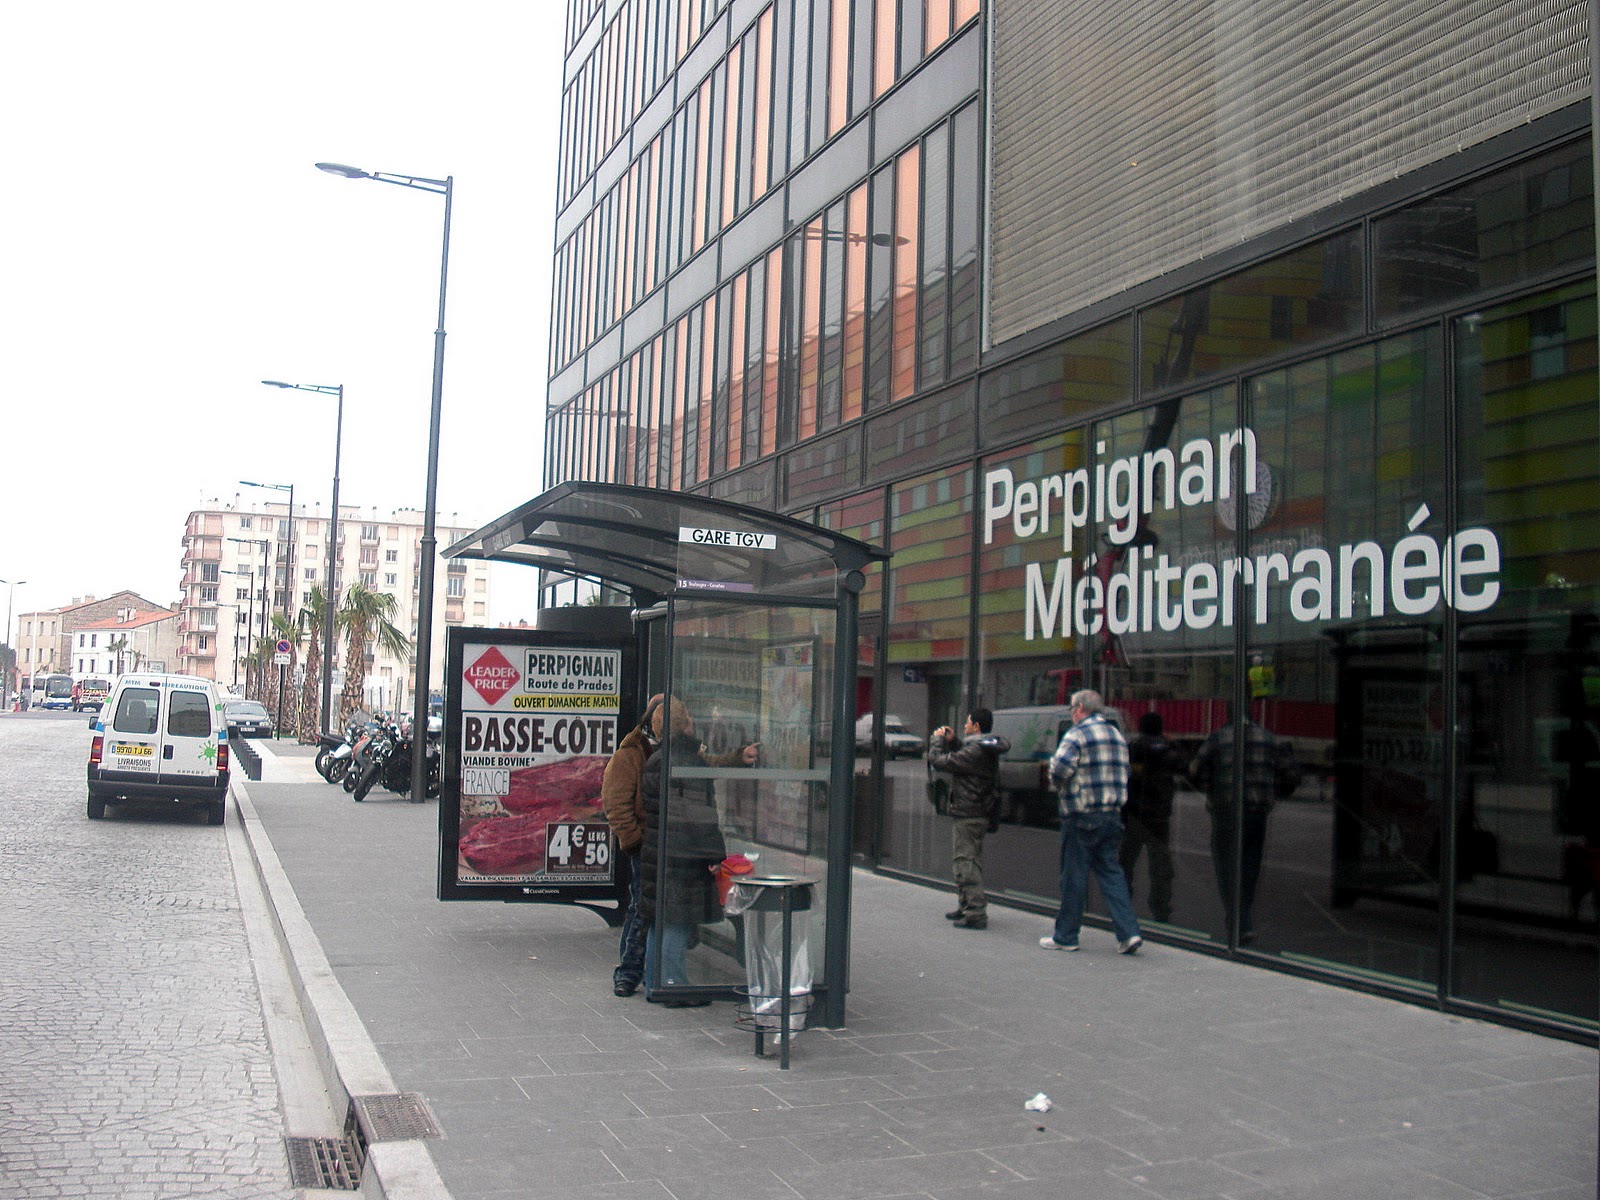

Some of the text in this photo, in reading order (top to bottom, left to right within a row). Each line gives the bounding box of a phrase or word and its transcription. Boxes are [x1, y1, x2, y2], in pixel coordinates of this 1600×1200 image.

[983, 427, 1258, 551] Perpignan
[692, 529, 764, 548] GARE TGV
[1025, 503, 1500, 640] Méditerranée
[470, 666, 516, 678] LEADER
[528, 654, 614, 677] PERPIGNAN
[161, 682, 209, 691] BUREAUTIQUE
[475, 679, 509, 690] PRICE
[528, 678, 613, 691] Route de Prades
[514, 696, 618, 708] OUVERT DIMANCHE MATIN
[465, 716, 615, 755] BASSE-CÔTE
[117, 758, 152, 767] LIVRAISONS
[463, 756, 496, 766] VIANDE
[465, 770, 509, 795] FRANCE
[588, 832, 606, 842] LE KG
[585, 843, 609, 865] 50
